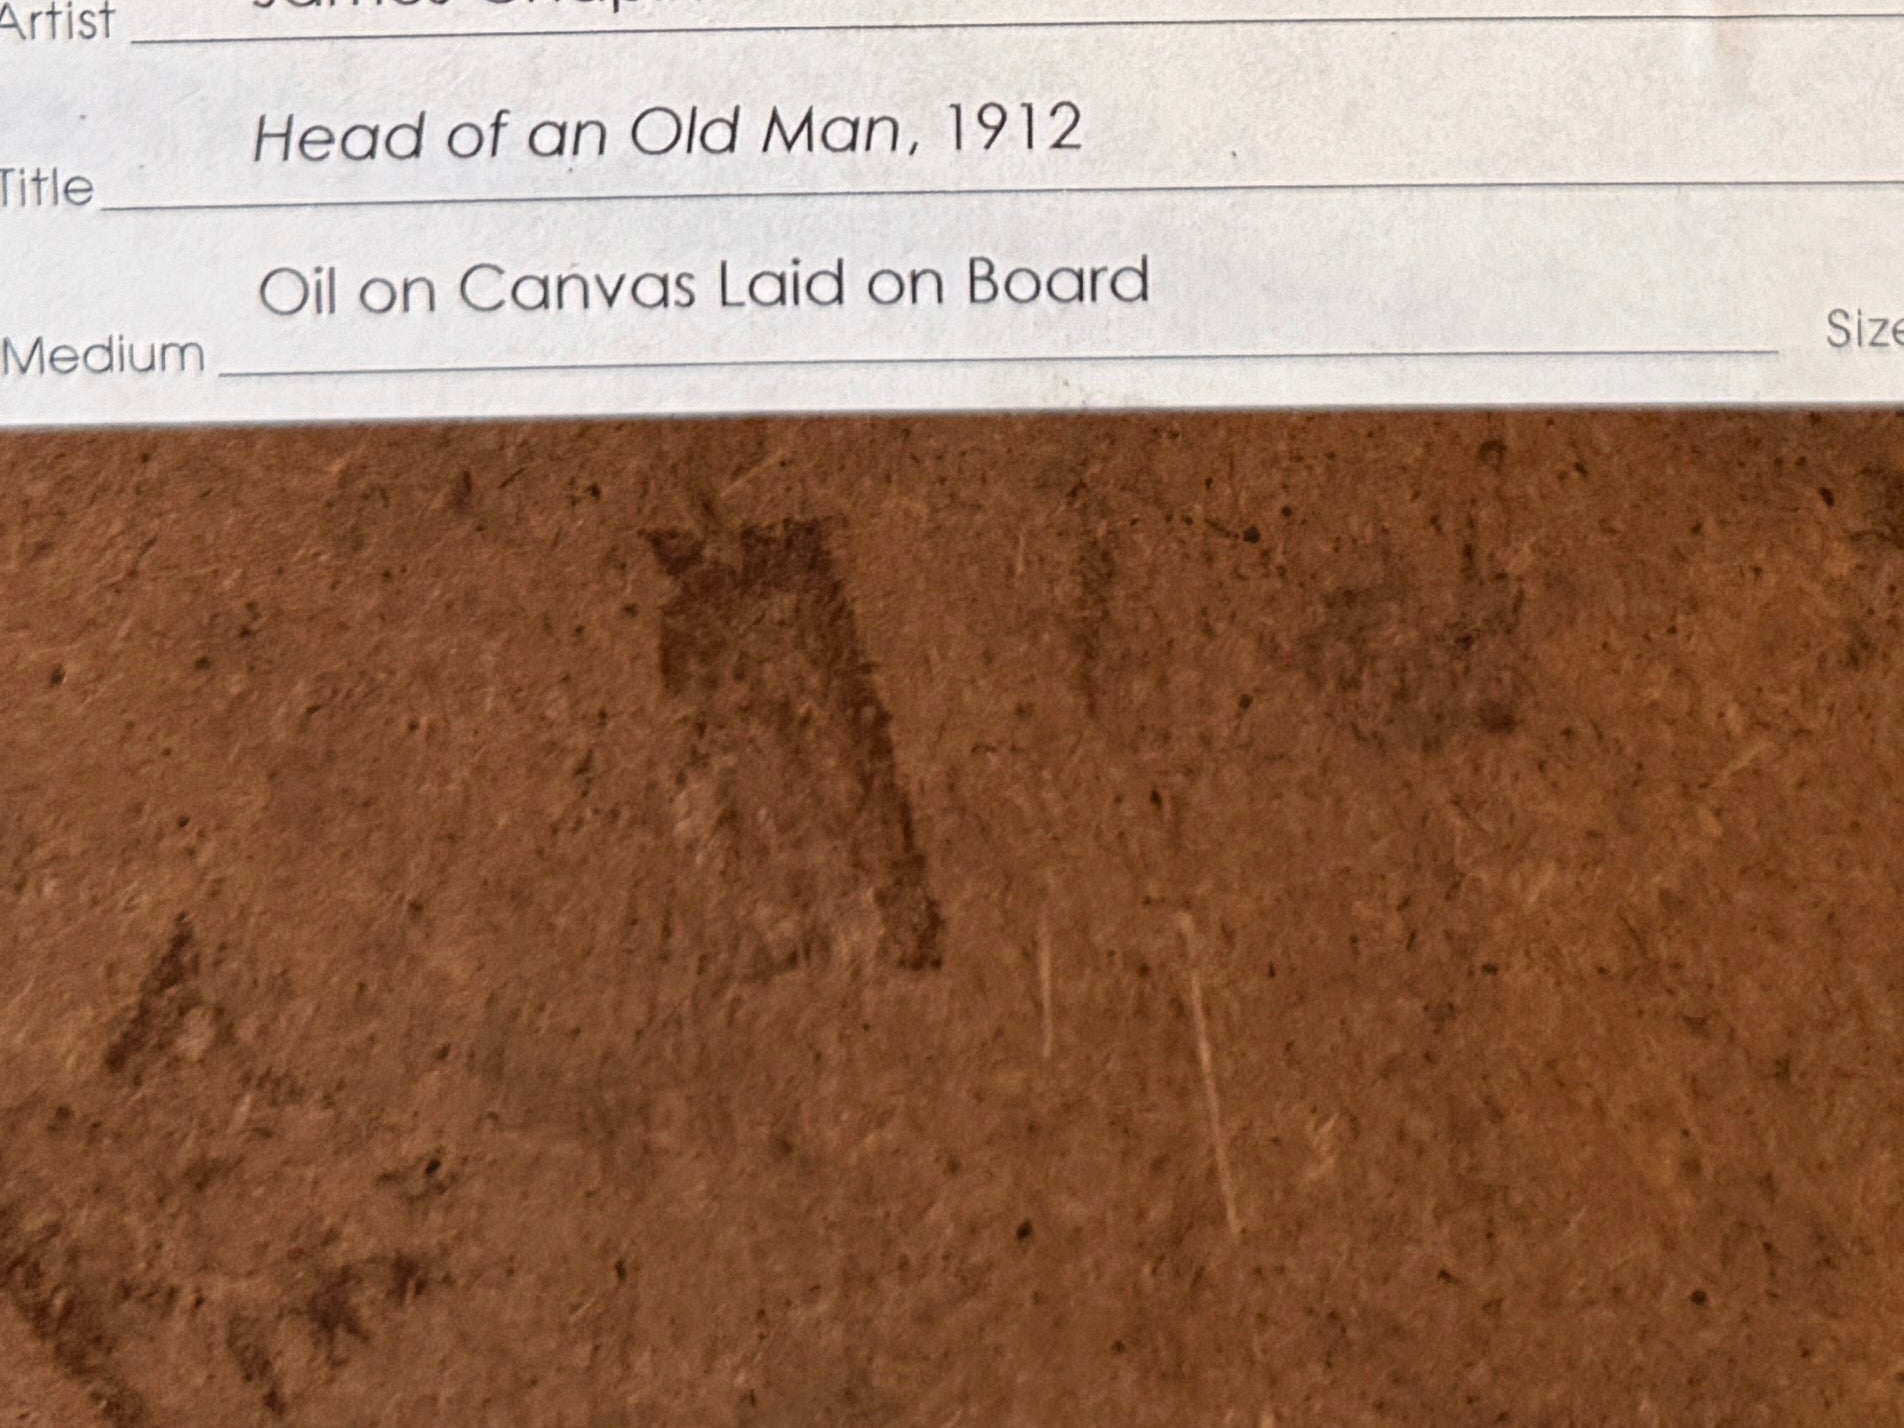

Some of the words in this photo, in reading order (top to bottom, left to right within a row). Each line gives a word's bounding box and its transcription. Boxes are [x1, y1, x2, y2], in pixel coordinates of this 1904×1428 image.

[252, 109, 427, 164] Head
[445, 108, 512, 161] of
[526, 119, 608, 159] an
[629, 103, 742, 157] Old
[760, 104, 919, 158] Man,
[947, 99, 1083, 153] 1912
[0, 333, 205, 377] Medium
[258, 265, 337, 318] Oil
[358, 276, 437, 316] on
[458, 262, 697, 314] Canvas
[719, 256, 845, 309] Laid
[866, 267, 945, 307] on
[968, 253, 1150, 307] Board
